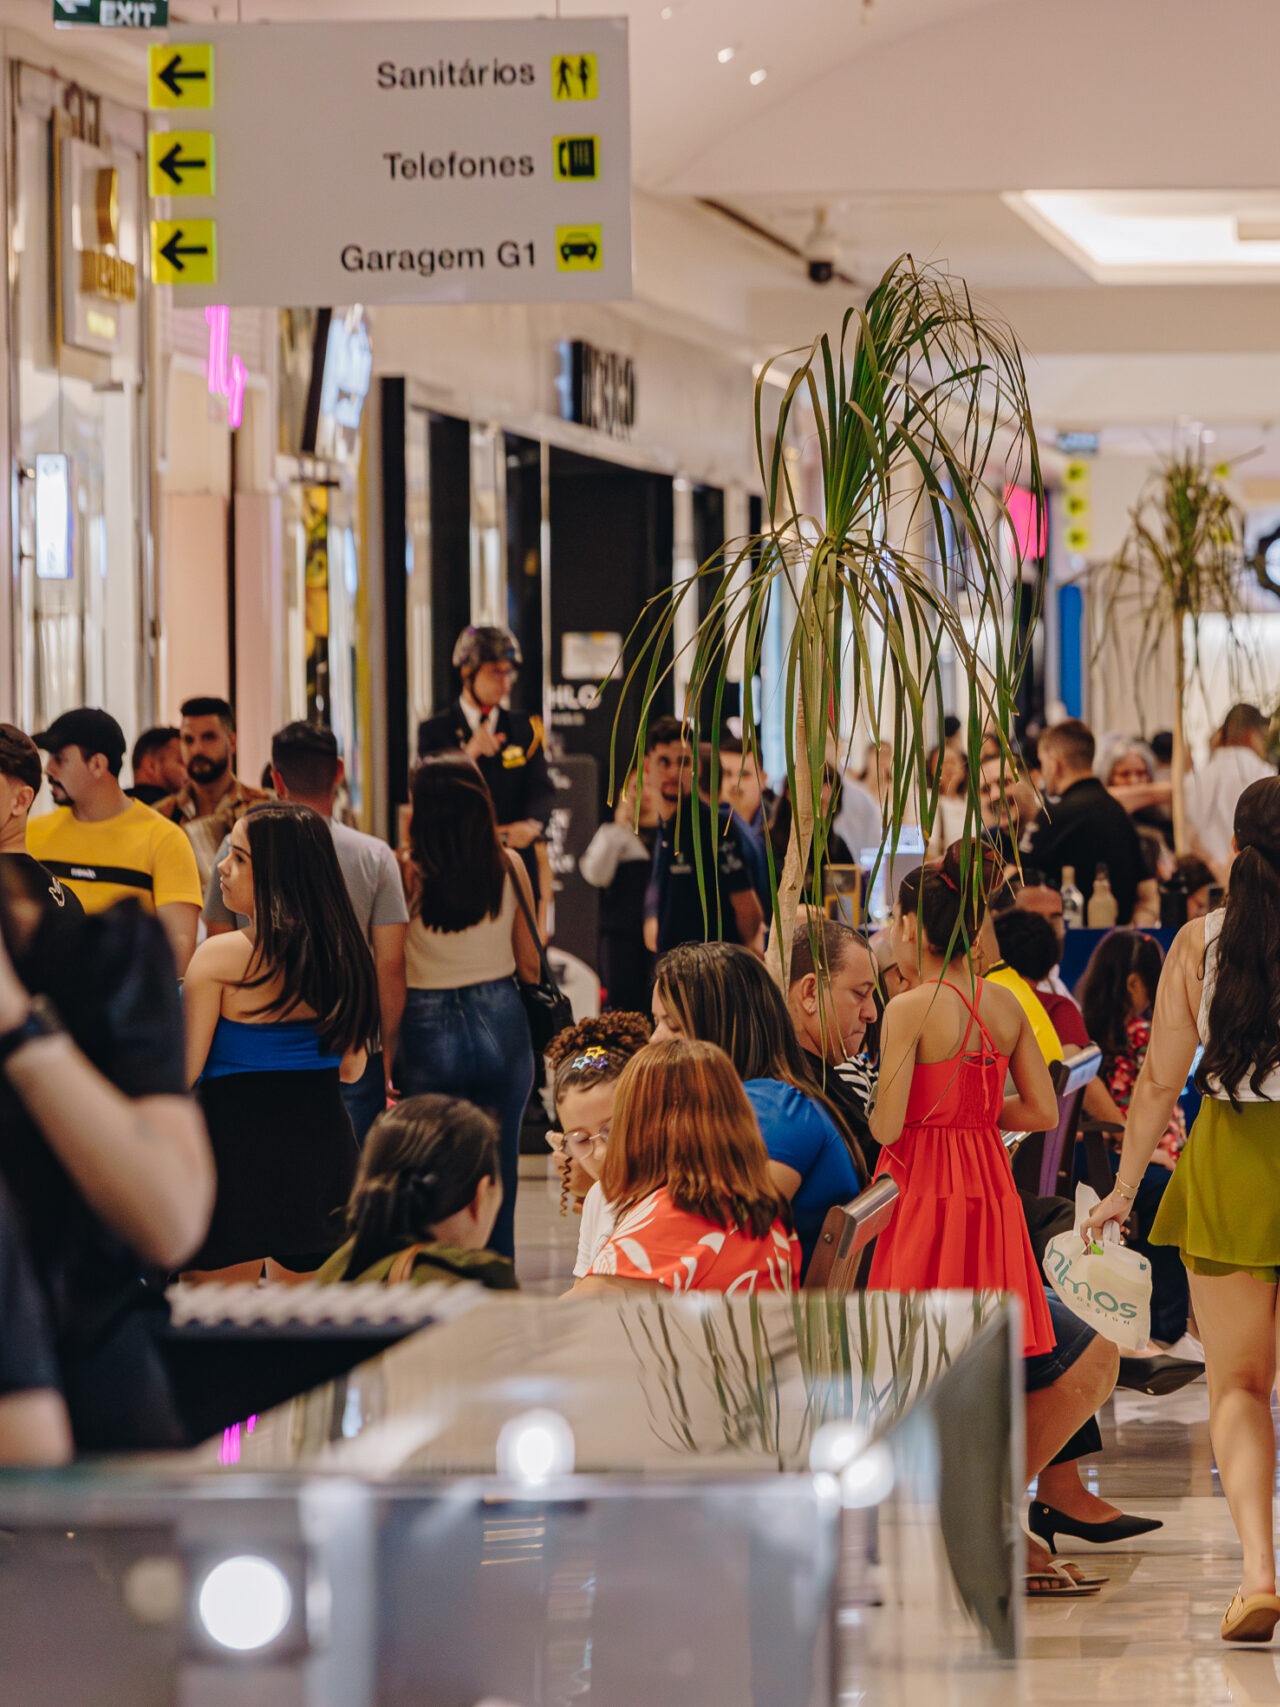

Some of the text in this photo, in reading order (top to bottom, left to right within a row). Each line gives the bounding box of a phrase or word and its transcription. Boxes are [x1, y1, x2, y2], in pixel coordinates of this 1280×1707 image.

[100, 1, 156, 27] EXIT
[376, 58, 536, 90] Sanitários
[382, 151, 535, 180] Telefones
[340, 240, 536, 277] Garagem G1
